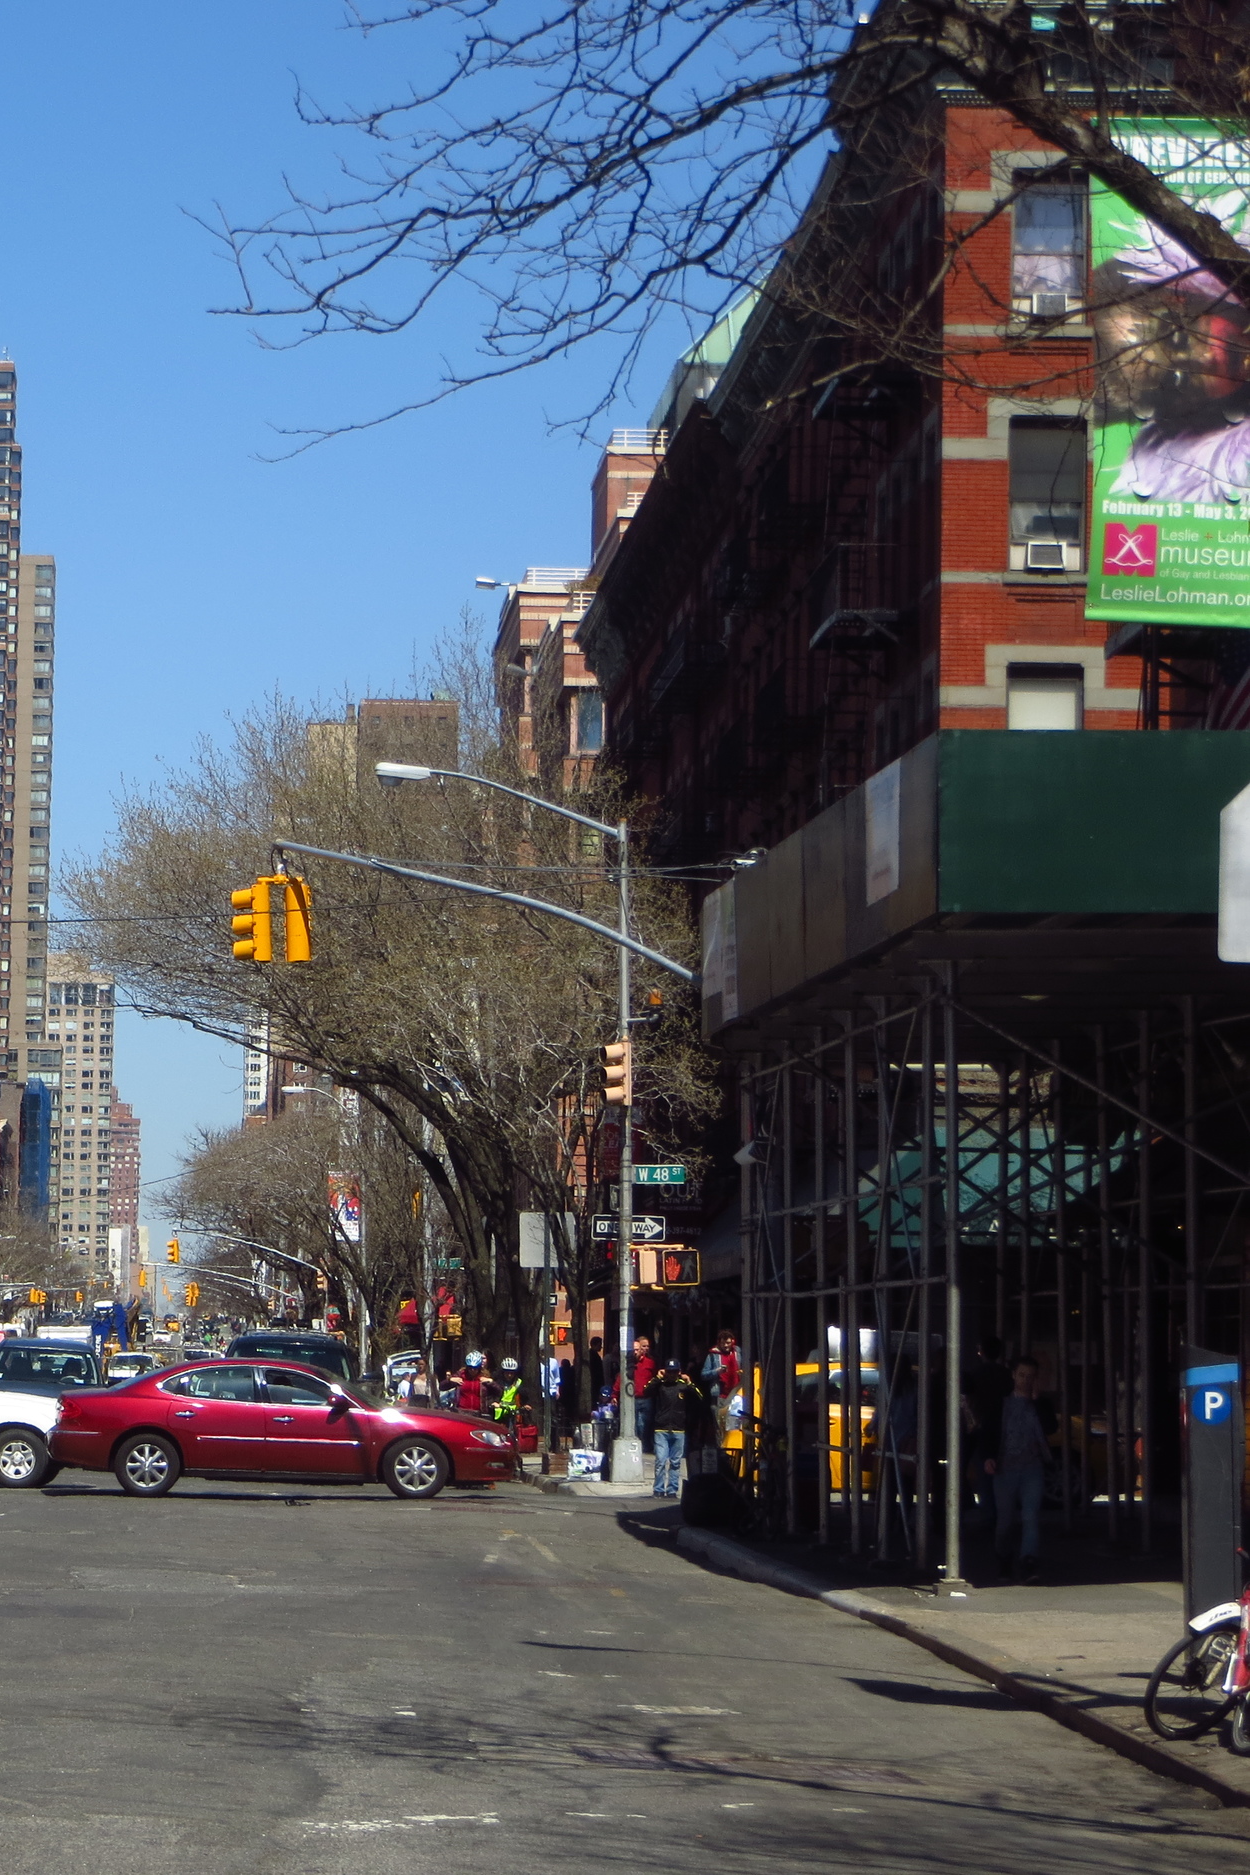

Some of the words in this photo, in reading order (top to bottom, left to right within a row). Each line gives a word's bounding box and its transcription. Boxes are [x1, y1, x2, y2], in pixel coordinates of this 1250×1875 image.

[1188, 171, 1202, 184] OF
[1102, 500, 1164, 517] February
[1167, 503, 1183, 517] 13
[1194, 504, 1221, 520] May
[1224, 506, 1236, 520] 3,
[1161, 528, 1199, 542] Leslie
[1160, 546, 1250, 567] museu
[1160, 568, 1169, 577] of
[1172, 569, 1190, 580] Gay
[1193, 571, 1210, 580] and
[1213, 571, 1250, 580] Lesbian
[638, 1168, 649, 1181] W
[653, 1168, 669, 1181] 48
[671, 1167, 681, 1176] ST
[634, 1223, 656, 1233] WAY
[1205, 1391, 1223, 1420] P
